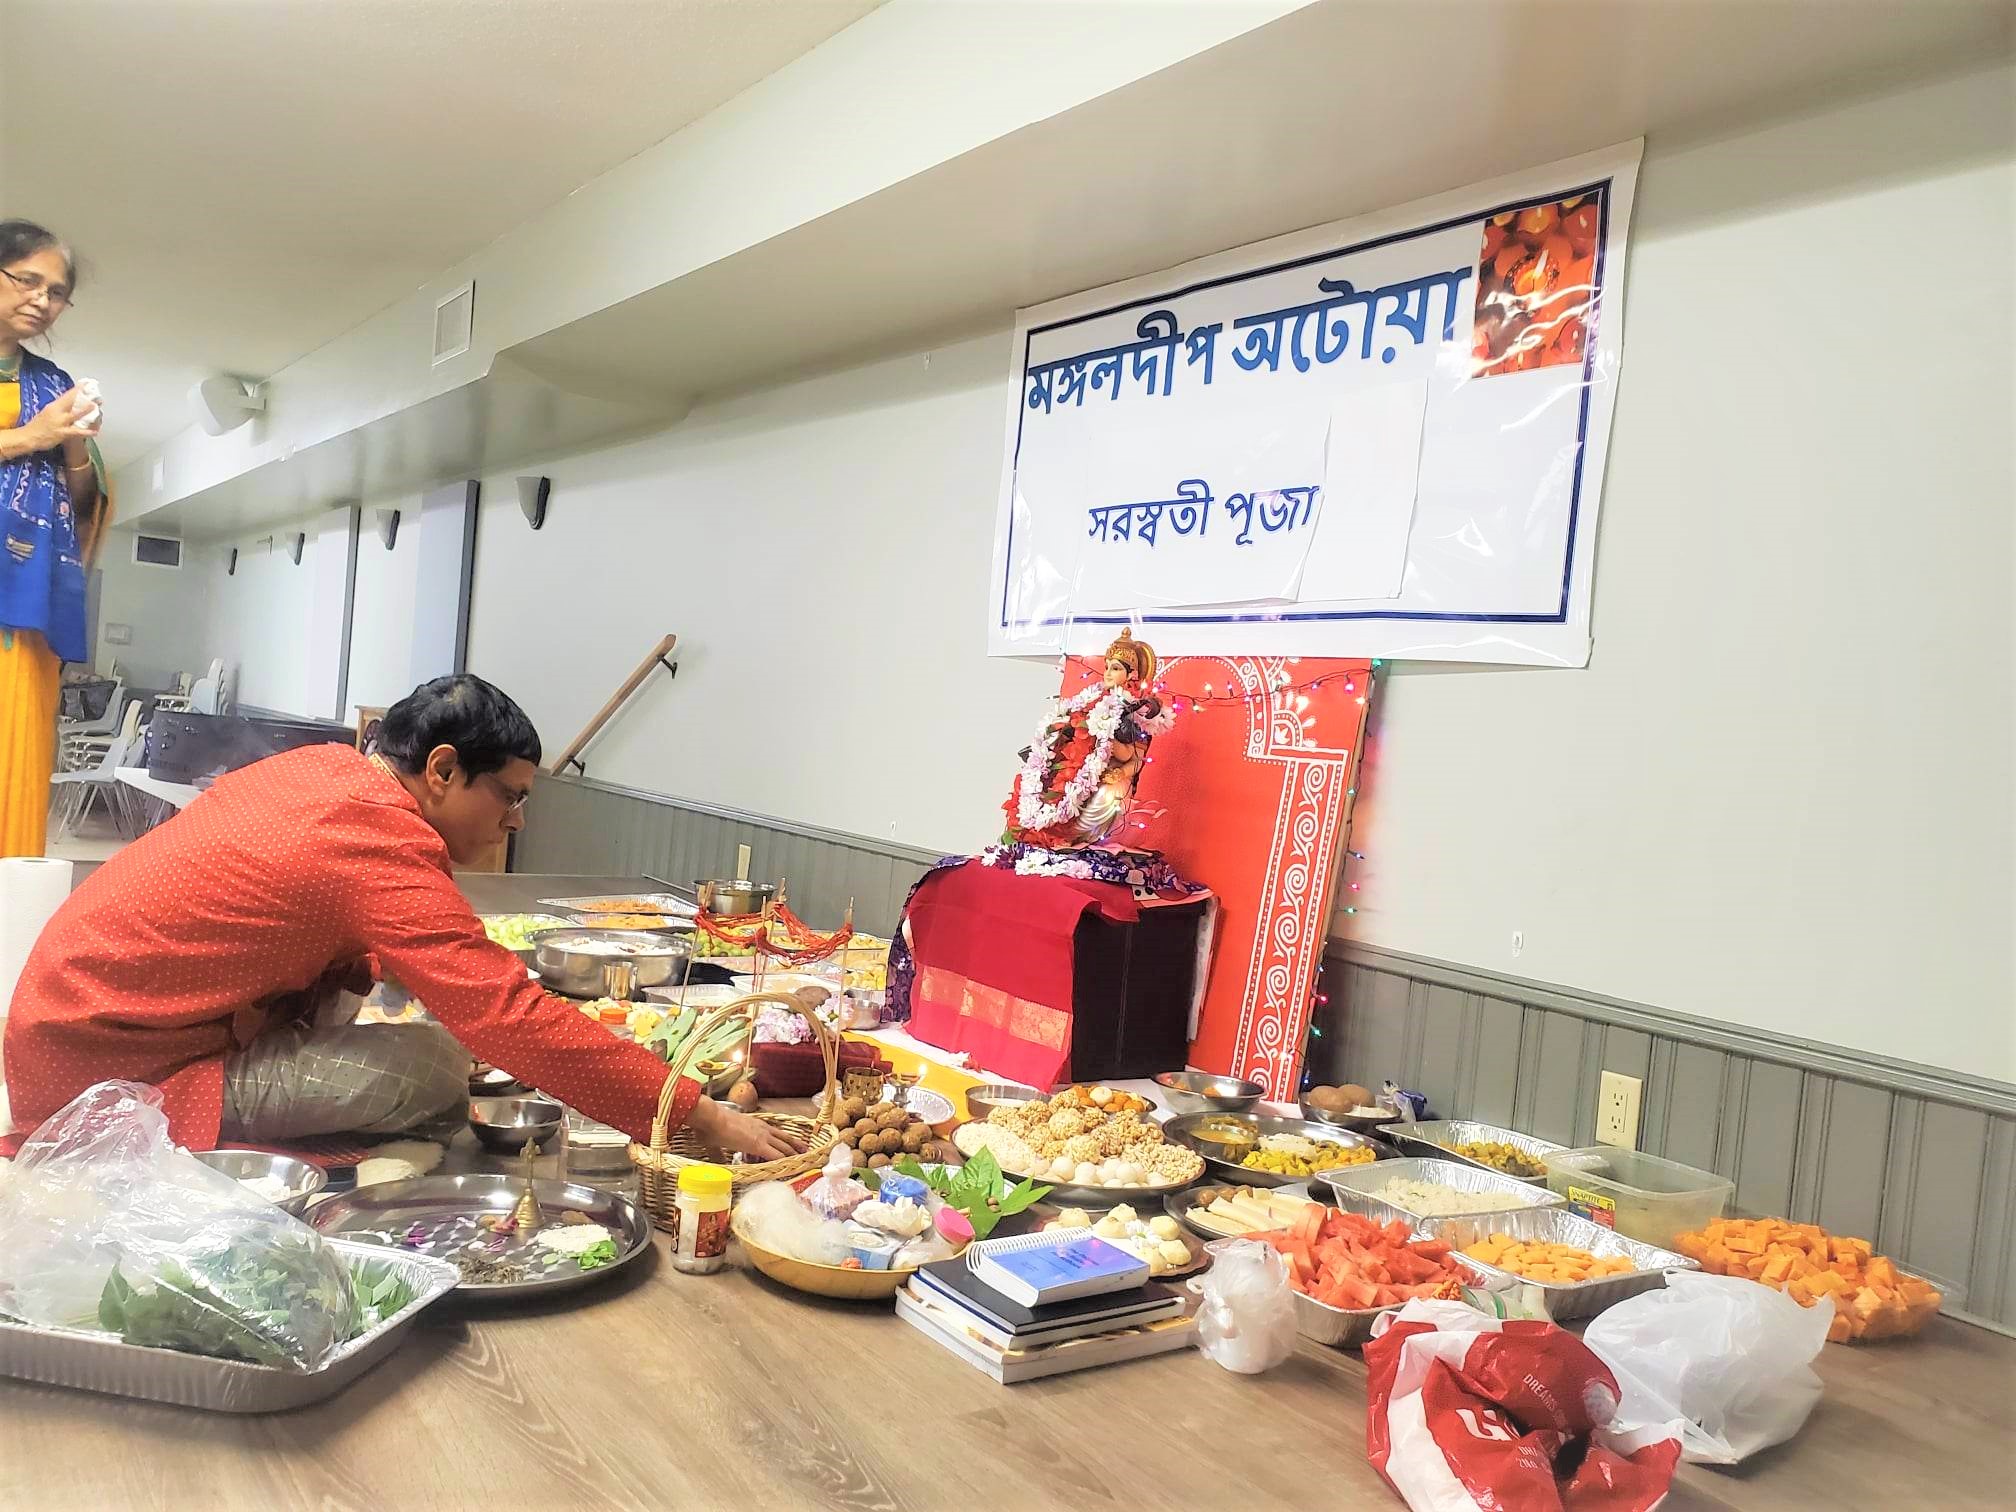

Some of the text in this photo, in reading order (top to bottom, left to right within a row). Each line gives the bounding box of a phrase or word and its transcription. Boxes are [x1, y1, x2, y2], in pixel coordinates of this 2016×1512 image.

[1027, 265, 1472, 415] মঙ্গলদীপ অটোয়া
[1088, 479, 1320, 547] সরস্বতী পূজা
